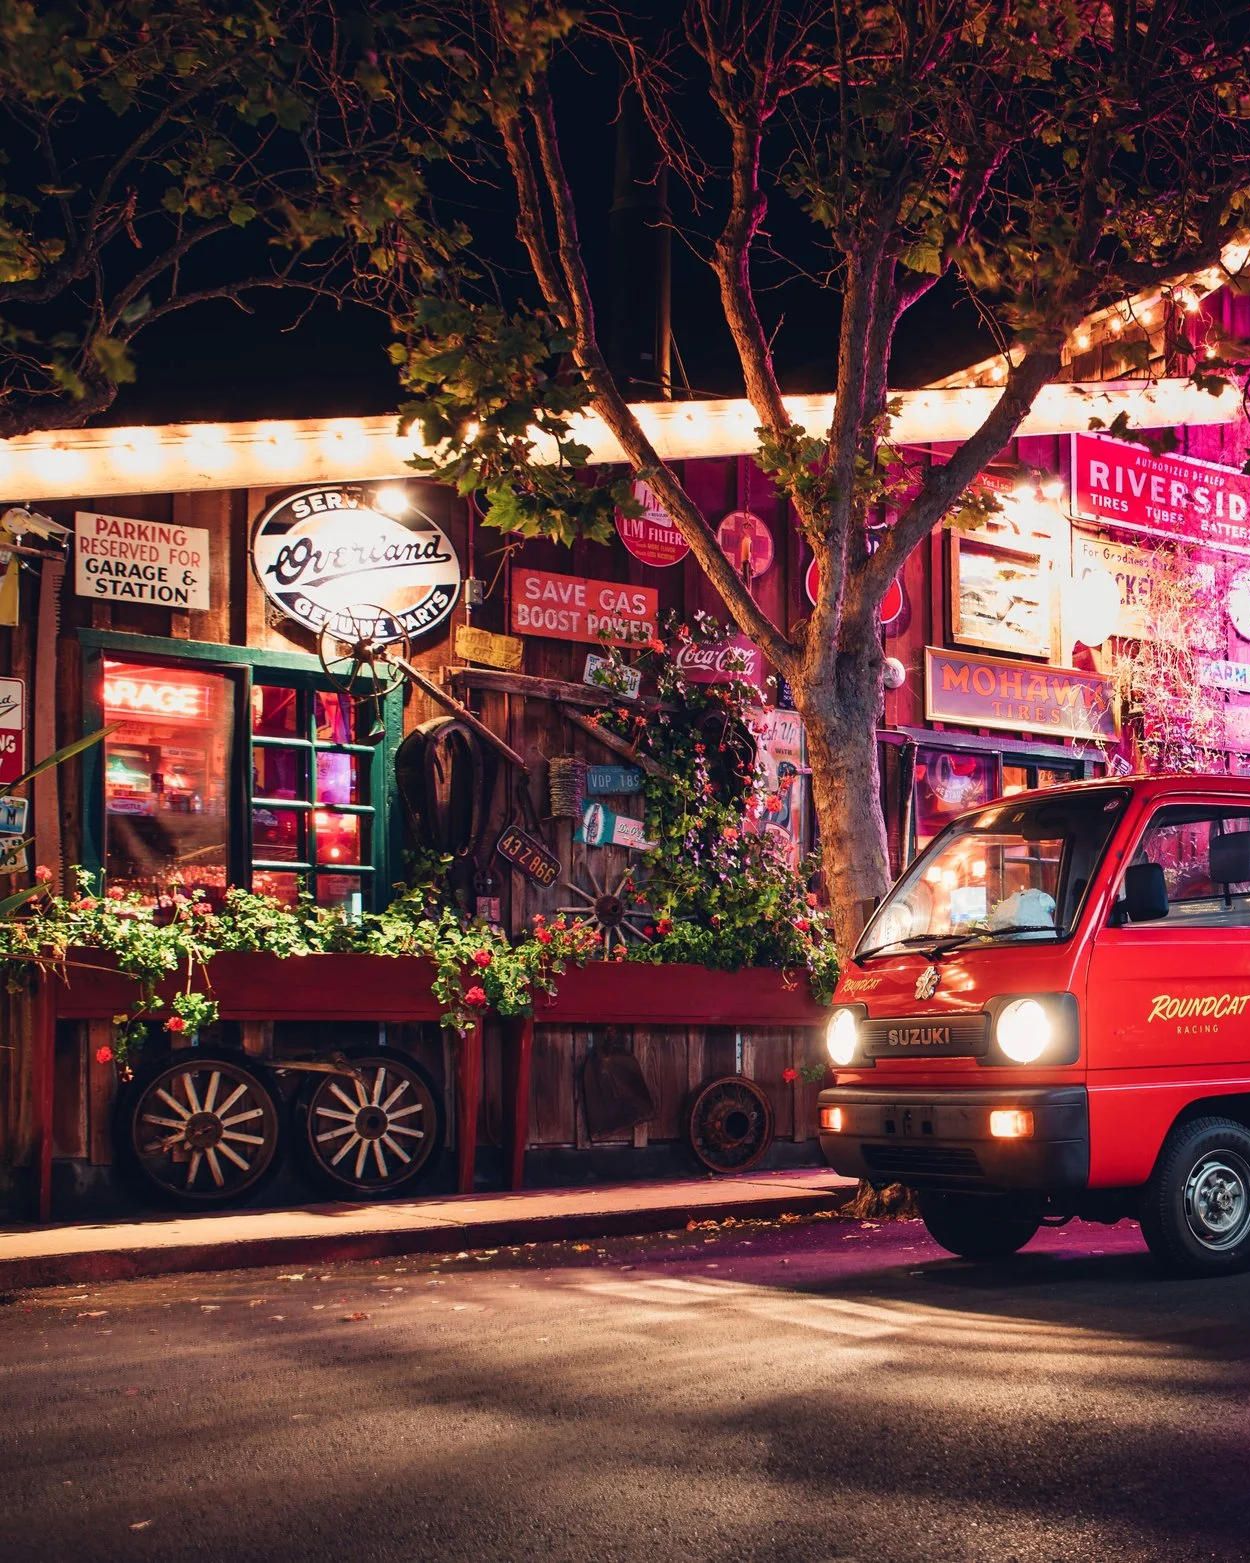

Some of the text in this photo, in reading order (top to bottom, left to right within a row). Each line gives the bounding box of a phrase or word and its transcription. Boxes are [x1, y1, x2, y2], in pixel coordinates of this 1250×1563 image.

[1136, 456, 1225, 487] AUTHORIZED DEALER
[1090, 493, 1129, 512] TIRES
[1145, 506, 1185, 526] TUBES
[96, 517, 188, 546] PARKING
[648, 527, 688, 547] FILTERS
[80, 536, 200, 568] RESERVED FOR
[266, 535, 452, 586] Overland
[85, 558, 198, 586] GARAGE &
[95, 578, 189, 604] STATION
[525, 577, 647, 615] SAVE GAS
[294, 590, 449, 637] GENUINE PARTS
[517, 603, 654, 644] BOOST POWER
[104, 681, 199, 714] ARAGE
[941, 663, 1107, 711] MOHAWK
[992, 701, 1061, 724] TIRES
[781, 722, 797, 744] Up
[888, 1027, 950, 1046] SUZUKI
[1177, 1024, 1219, 1034] RACING
